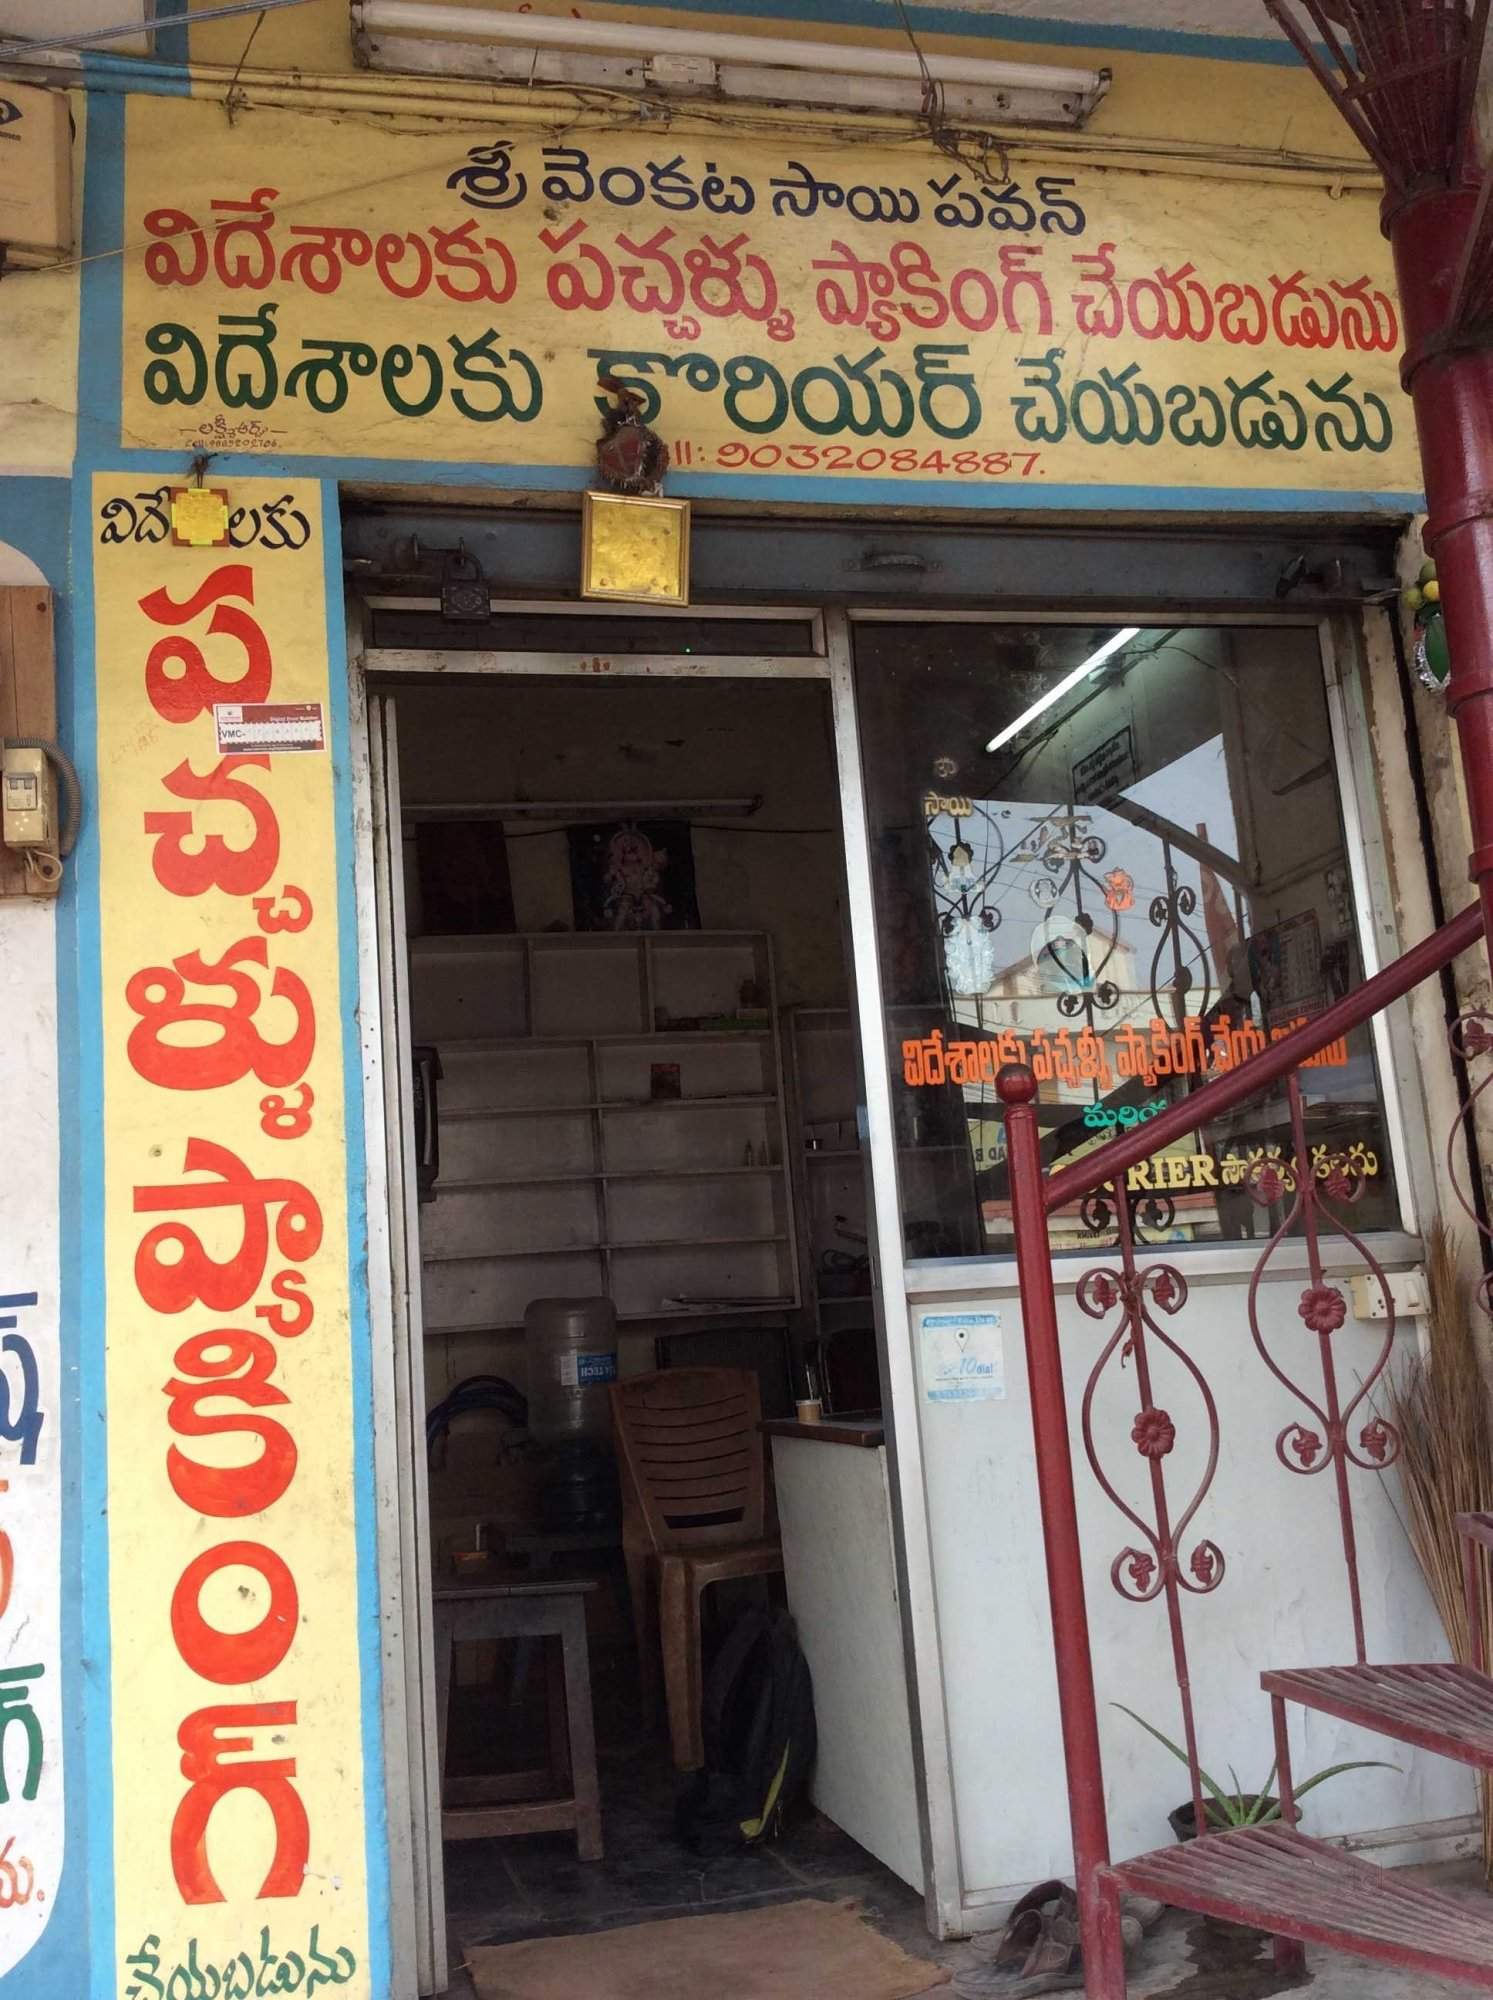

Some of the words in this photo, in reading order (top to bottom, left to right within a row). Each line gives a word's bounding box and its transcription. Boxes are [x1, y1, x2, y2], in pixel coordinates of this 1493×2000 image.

[446, 139, 528, 210] శ్రీ
[541, 144, 756, 215] వెంకట
[769, 160, 921, 224] సాయి
[926, 172, 1087, 237] పవన్
[143, 187, 518, 304] విదేశాలకు
[811, 240, 1054, 343] ప్యాకింగ్
[1070, 241, 1399, 354] చేయబడును
[143, 302, 544, 423] విదేశాలకు
[1010, 347, 1395, 454] చేయబడును
[100, 485, 311, 550] విదేలకు
